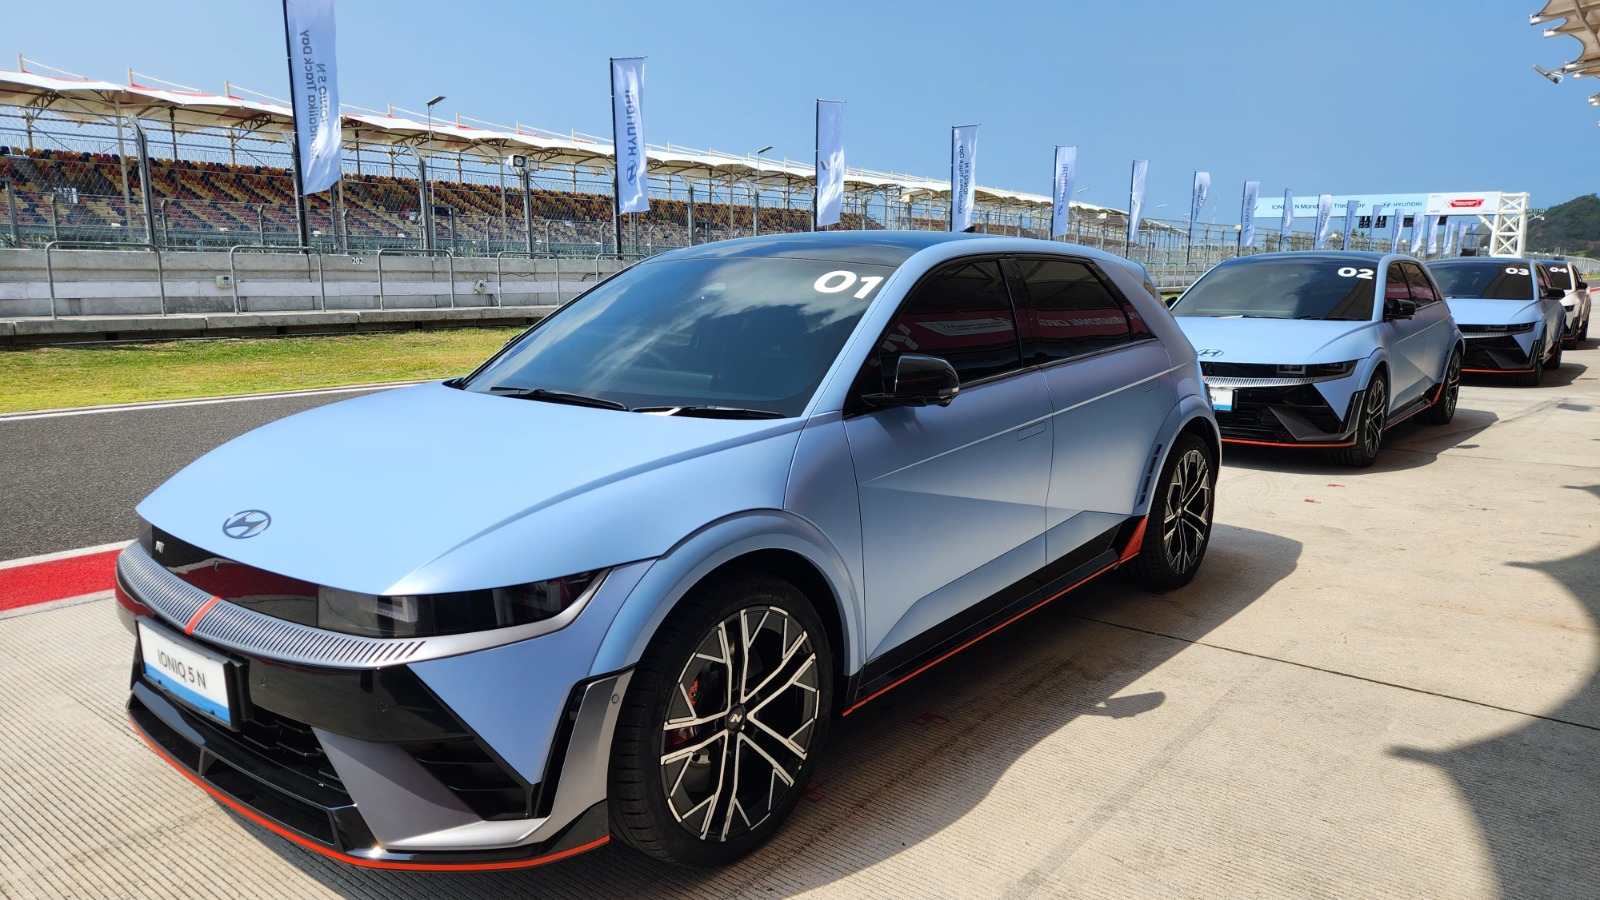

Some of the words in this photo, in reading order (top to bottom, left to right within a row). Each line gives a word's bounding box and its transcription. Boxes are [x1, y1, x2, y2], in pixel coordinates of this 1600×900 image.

[351, 257, 364, 265] 202
[1337, 267, 1374, 280] 02
[1505, 267, 1530, 276] 03
[1549, 266, 1568, 274] 04
[813, 269, 884, 300] 01
[157, 648, 188, 683] IONIQ
[188, 667, 196, 683] 5
[196, 670, 207, 690] N
